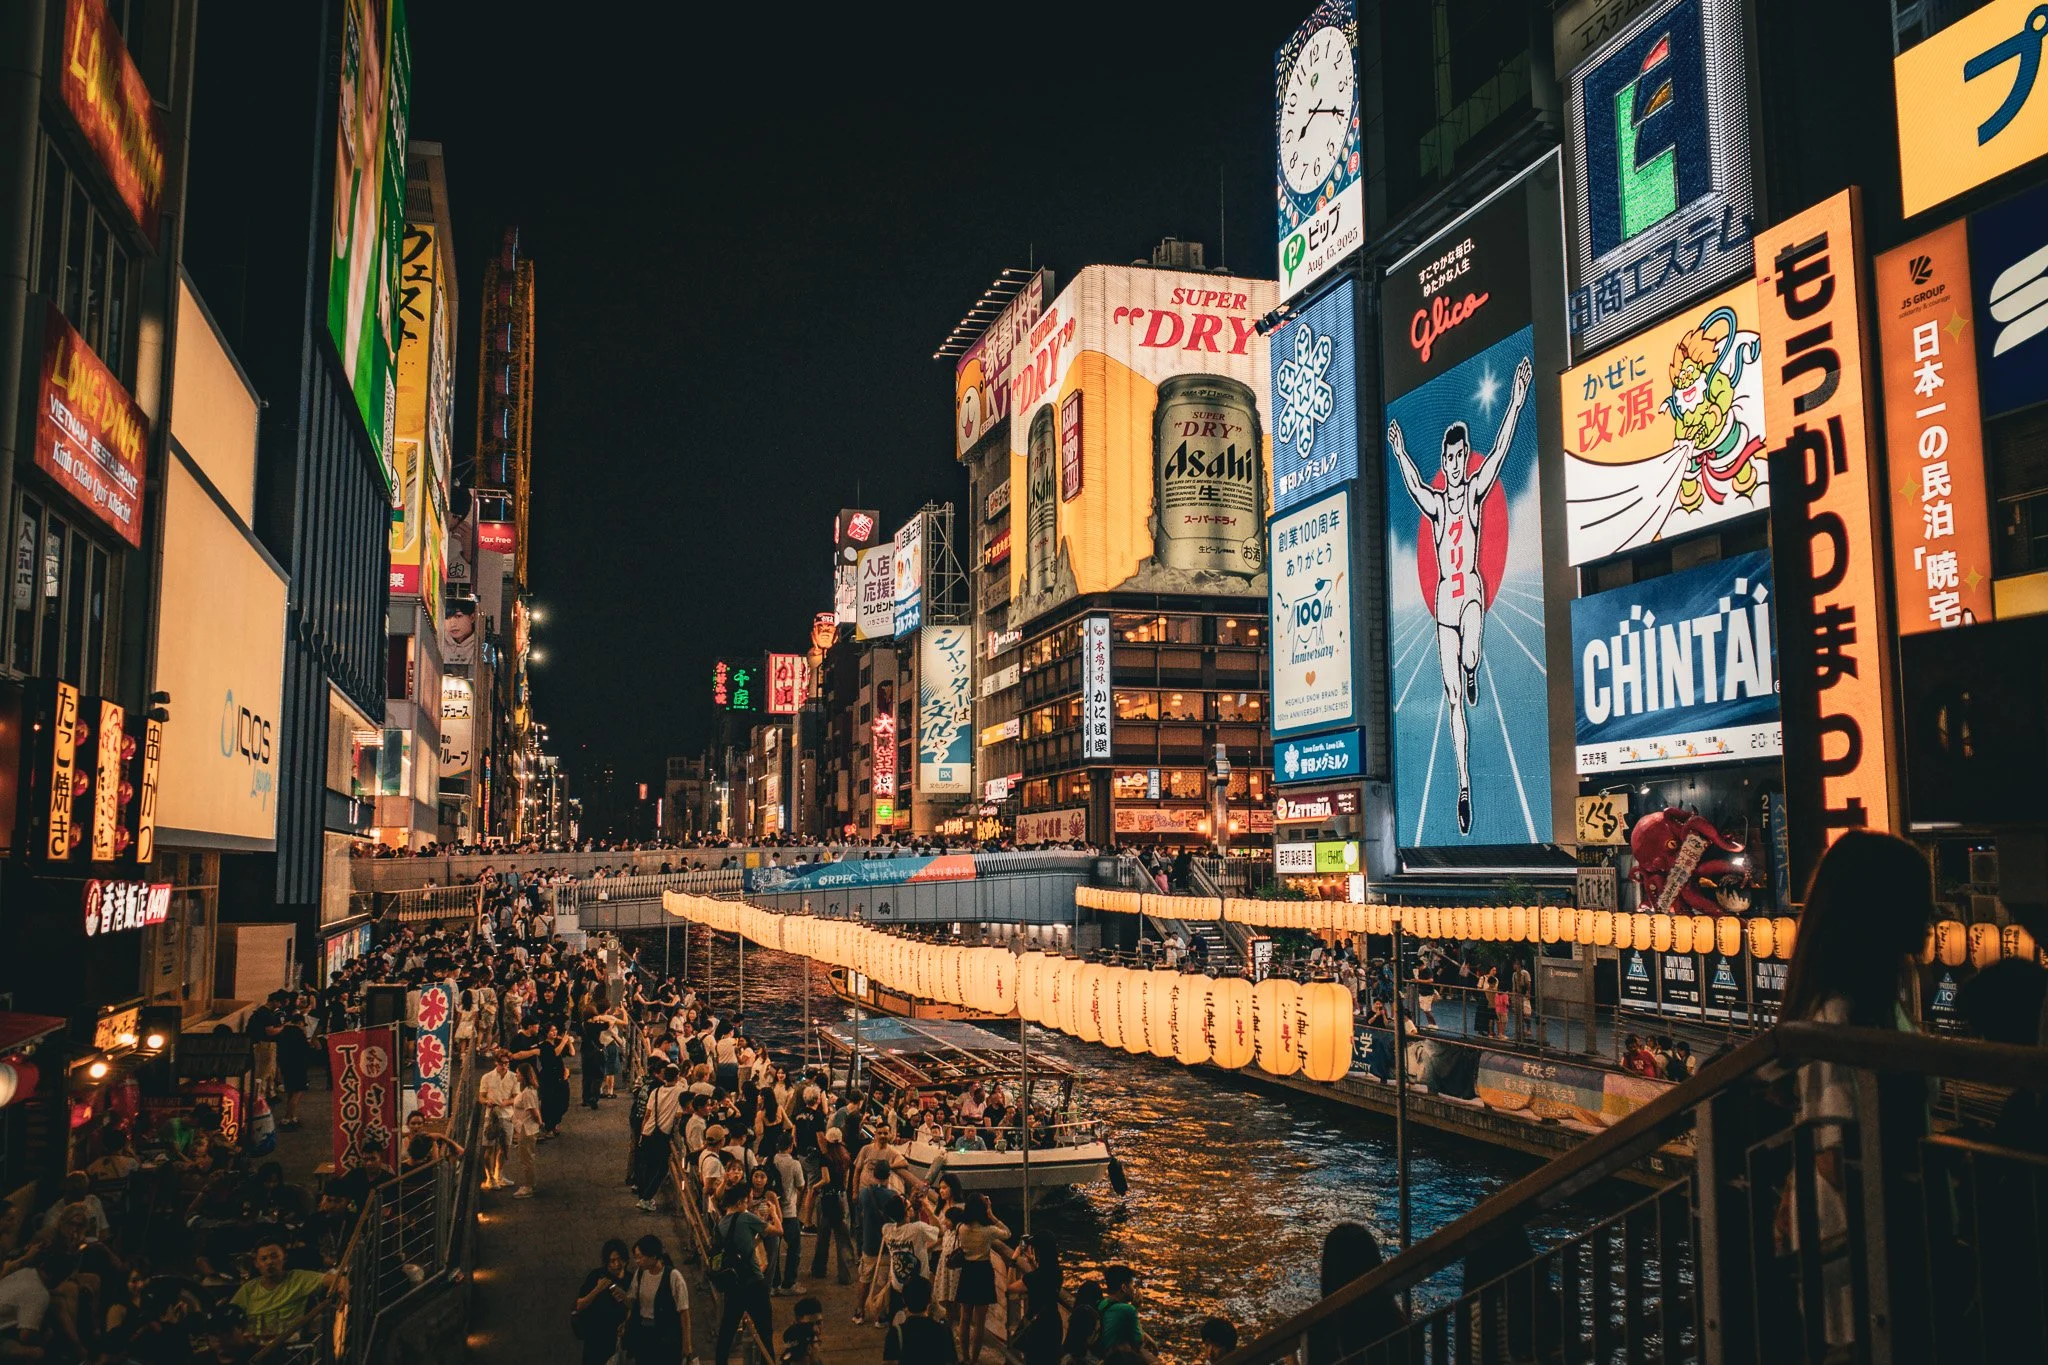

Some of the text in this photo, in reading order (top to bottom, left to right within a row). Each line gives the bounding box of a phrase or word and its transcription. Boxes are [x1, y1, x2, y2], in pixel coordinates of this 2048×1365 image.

[1309, 43, 1320, 66] 12
[1325, 40, 1331, 59] 1
[1335, 51, 1343, 70] 2
[70, 3, 121, 135] LONG
[1296, 66, 1307, 86] 11
[1339, 80, 1348, 92] 3
[1286, 93, 1297, 115] 10
[1285, 130, 1293, 143] 9
[1327, 139, 1336, 157] 5
[1290, 152, 1298, 169] 8
[1301, 163, 1309, 180] 7
[1313, 157, 1321, 176] 6
[1309, 202, 1342, 250] ピップ
[1307, 254, 1326, 275] Aug.
[1337, 228, 1358, 253] 2025
[1419, 238, 1475, 285] すこやかな毎日、
[1423, 258, 1471, 298] ゆたかな人生
[1568, 206, 1752, 335] 日商エステム
[1171, 287, 1247, 311] SUPER
[1901, 284, 1946, 310] JS GROUP
[1030, 308, 1058, 354] SUPER
[1411, 293, 1489, 363] Glico
[1583, 355, 1646, 401] かぜに
[51, 336, 142, 464] LONG DINH
[1192, 411, 1225, 421] SUPER
[1577, 378, 1655, 453] 改源
[49, 394, 138, 494] VIETNAM RESTAURANT
[1912, 319, 1955, 540] 日本一の民泊
[52, 441, 73, 474] Kính
[1164, 440, 1252, 484] Asahi
[1198, 485, 1221, 501] 生
[1184, 515, 1237, 526] スーパードライ
[1278, 510, 1340, 552] 創業100周年
[481, 535, 512, 544] Tax Free
[1198, 546, 1222, 554] 生ビール
[1243, 545, 1261, 563] お酒
[1286, 543, 1333, 577] ありがとう
[1448, 516, 1465, 598] グリコ
[863, 601, 893, 615] プレゼント
[1095, 640, 1105, 684] 本場の味
[1289, 643, 1334, 666] Anniversary
[1583, 578, 1773, 724] CHINTAI
[733, 669, 750, 705] 千房
[1321, 689, 1338, 700] BRAND
[236, 705, 272, 765] IQOS
[1094, 690, 1107, 752] かに道楽
[51, 687, 75, 857] たこ焼き
[941, 770, 951, 779] BX
[140, 724, 161, 860] 串かつ
[1288, 801, 1332, 818] ZETTERIA
[1586, 802, 1618, 838] くくる
[1761, 794, 1770, 829] 2F
[100, 882, 149, 933] 香港飯店
[1664, 967, 1676, 980] NEW
[1677, 969, 1695, 981] WORLD
